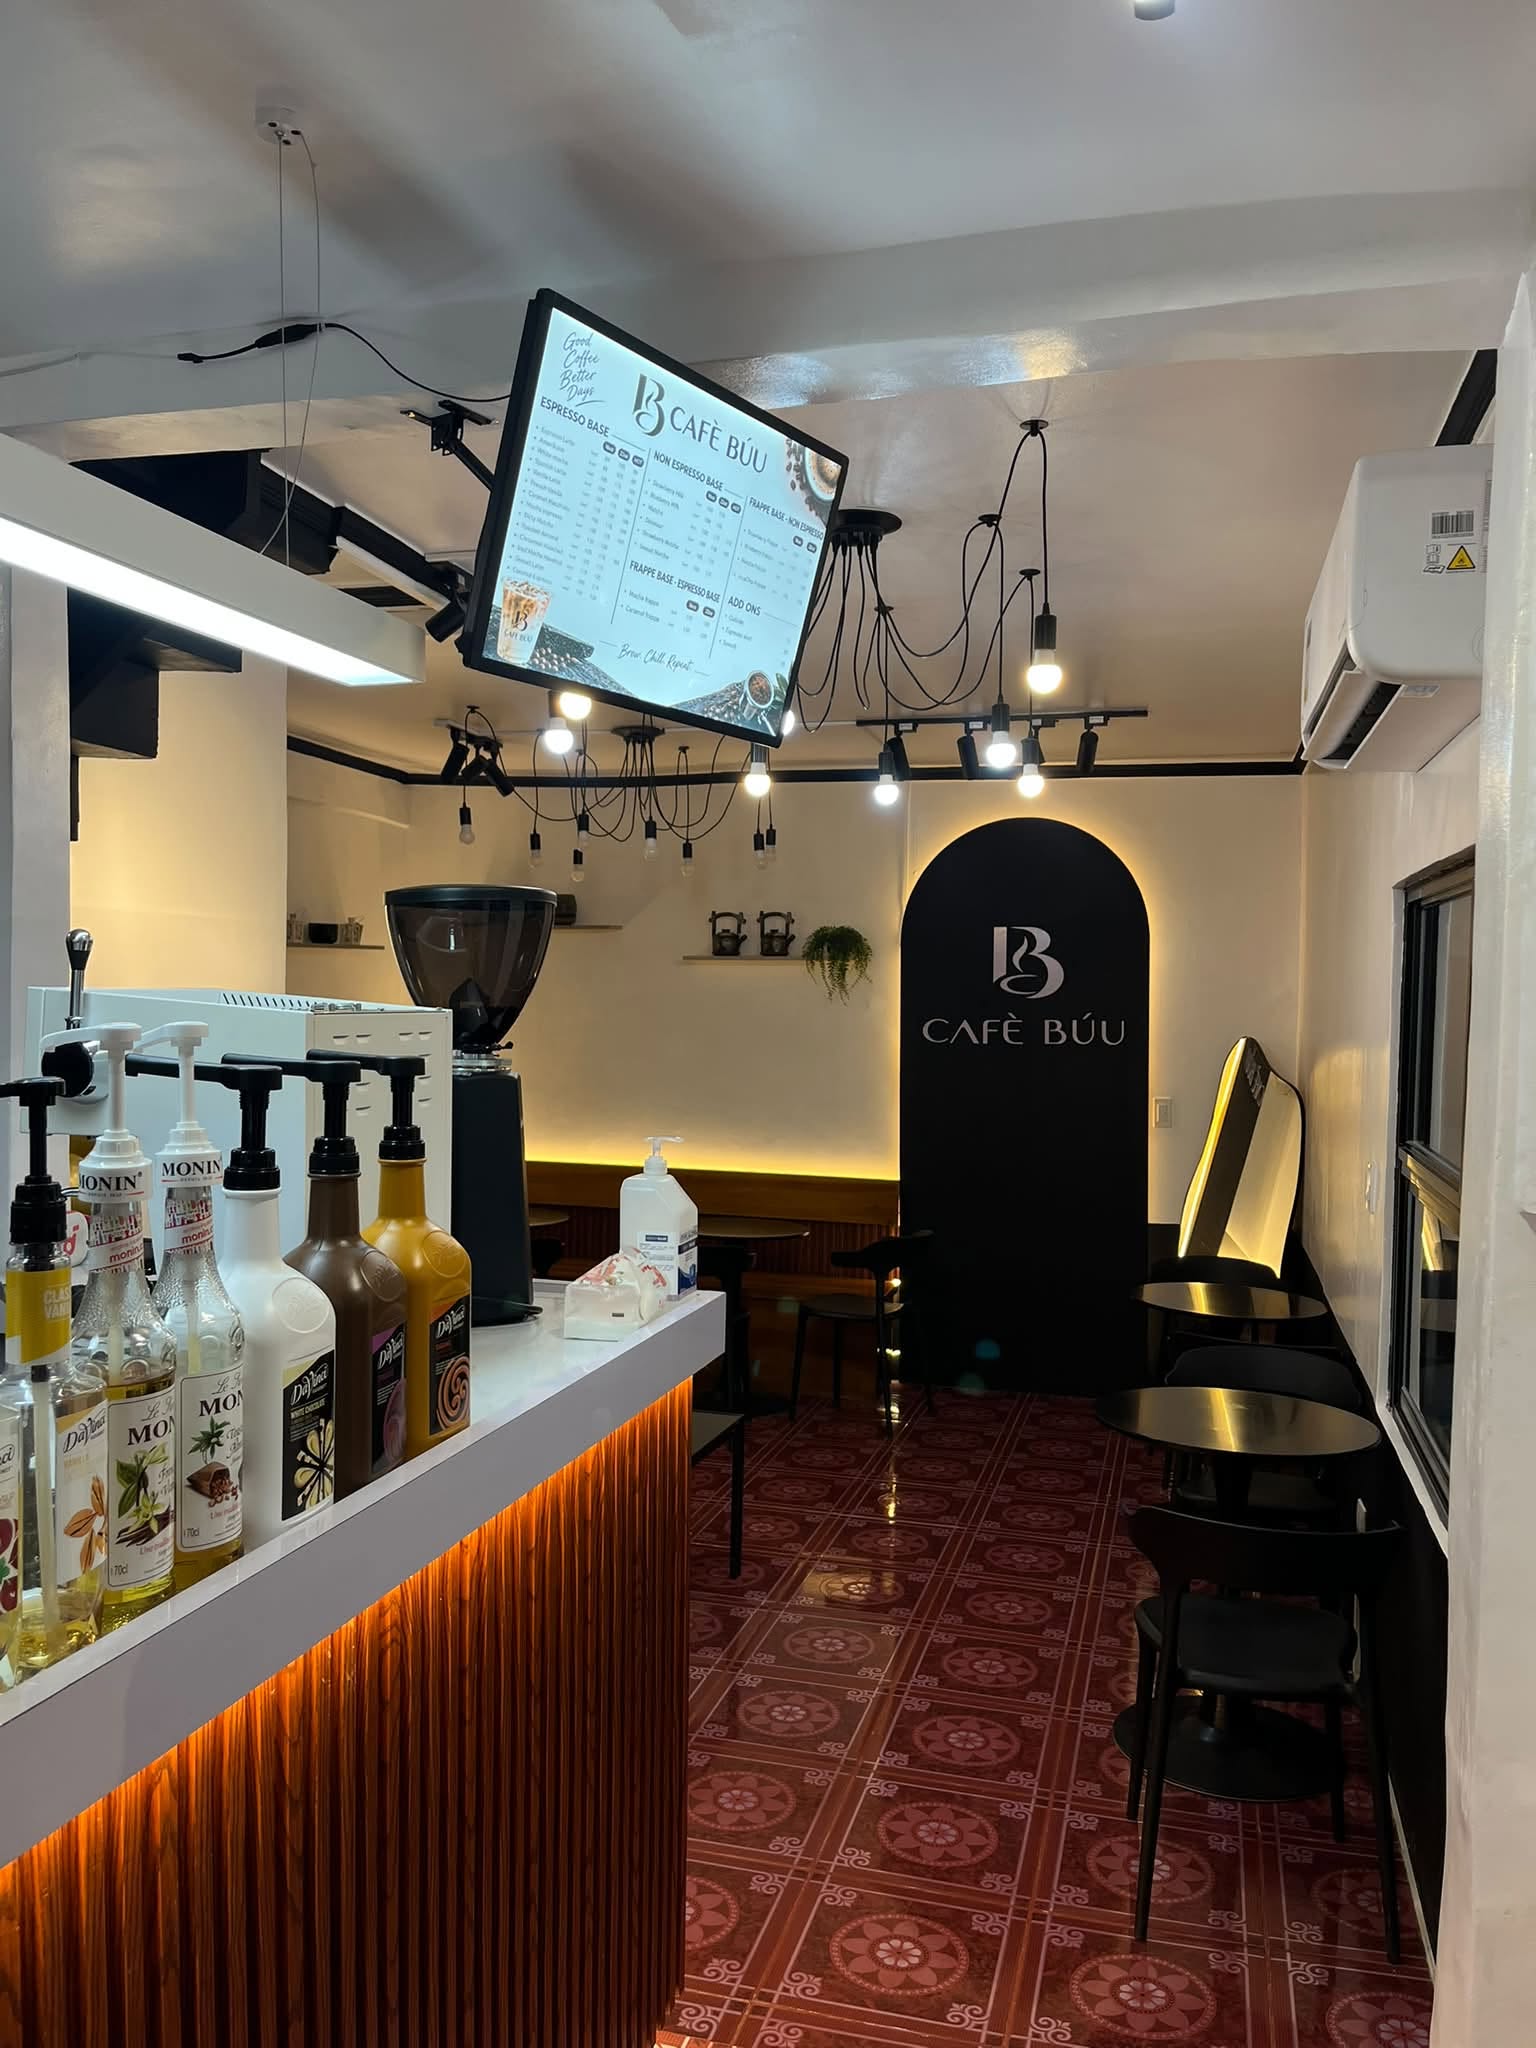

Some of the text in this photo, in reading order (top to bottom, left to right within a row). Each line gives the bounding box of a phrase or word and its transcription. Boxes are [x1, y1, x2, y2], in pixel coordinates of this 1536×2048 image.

[563, 332, 593, 351] Good
[564, 350, 599, 368] Coffee
[560, 369, 597, 390] Better
[567, 385, 594, 402] Days
[541, 397, 610, 437] ESPRESSO BASE
[670, 406, 767, 473] CAFÈ BÚU
[654, 450, 723, 491] NON ESPRESSO BASE
[749, 497, 771, 515] FRAPPE
[771, 508, 785, 522] BASE
[789, 516, 800, 529] NON
[800, 522, 824, 540] ESPRESSO
[630, 560, 656, 578] FRAPPE
[656, 570, 674, 585] BASE
[677, 579, 706, 597] ESPRESSO
[706, 590, 720, 603] BASE
[728, 596, 744, 609] ADD
[745, 602, 761, 616] ONS
[922, 1012, 1125, 1046] CAFÈ BÚU
[290, 1362, 329, 1406] DaVinci
[63, 1408, 106, 1454] DaVinci
